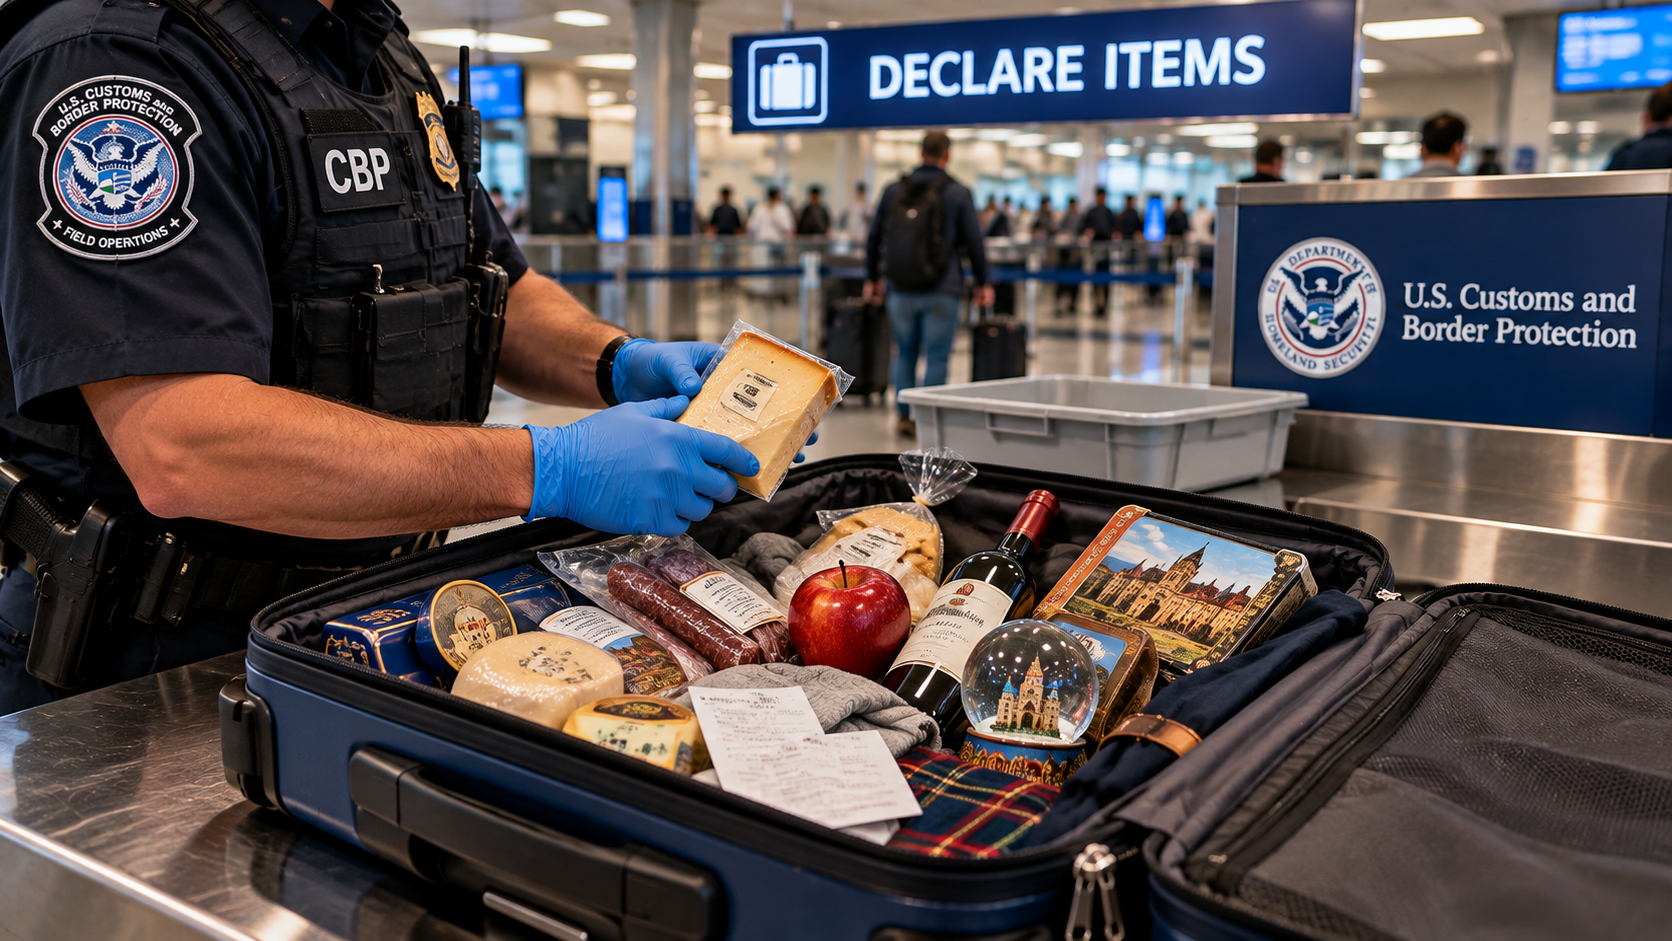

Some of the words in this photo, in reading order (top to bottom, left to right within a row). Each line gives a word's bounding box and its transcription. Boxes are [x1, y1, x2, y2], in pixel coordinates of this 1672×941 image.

[870, 45, 1084, 99] DECLARE
[1104, 35, 1266, 90] ITEMS
[50, 101, 99, 137] BORDER
[103, 98, 183, 137] PROTECTION
[58, 96, 85, 115] U.S.
[85, 85, 152, 101] CUSTOMS
[325, 147, 391, 194] CBP
[63, 226, 95, 246] FIELD
[1403, 282, 1453, 309] U.S.
[1459, 283, 1575, 312] Customs
[1581, 284, 1637, 313] and
[1401, 314, 1490, 343] Border
[1494, 318, 1637, 349] Protection
